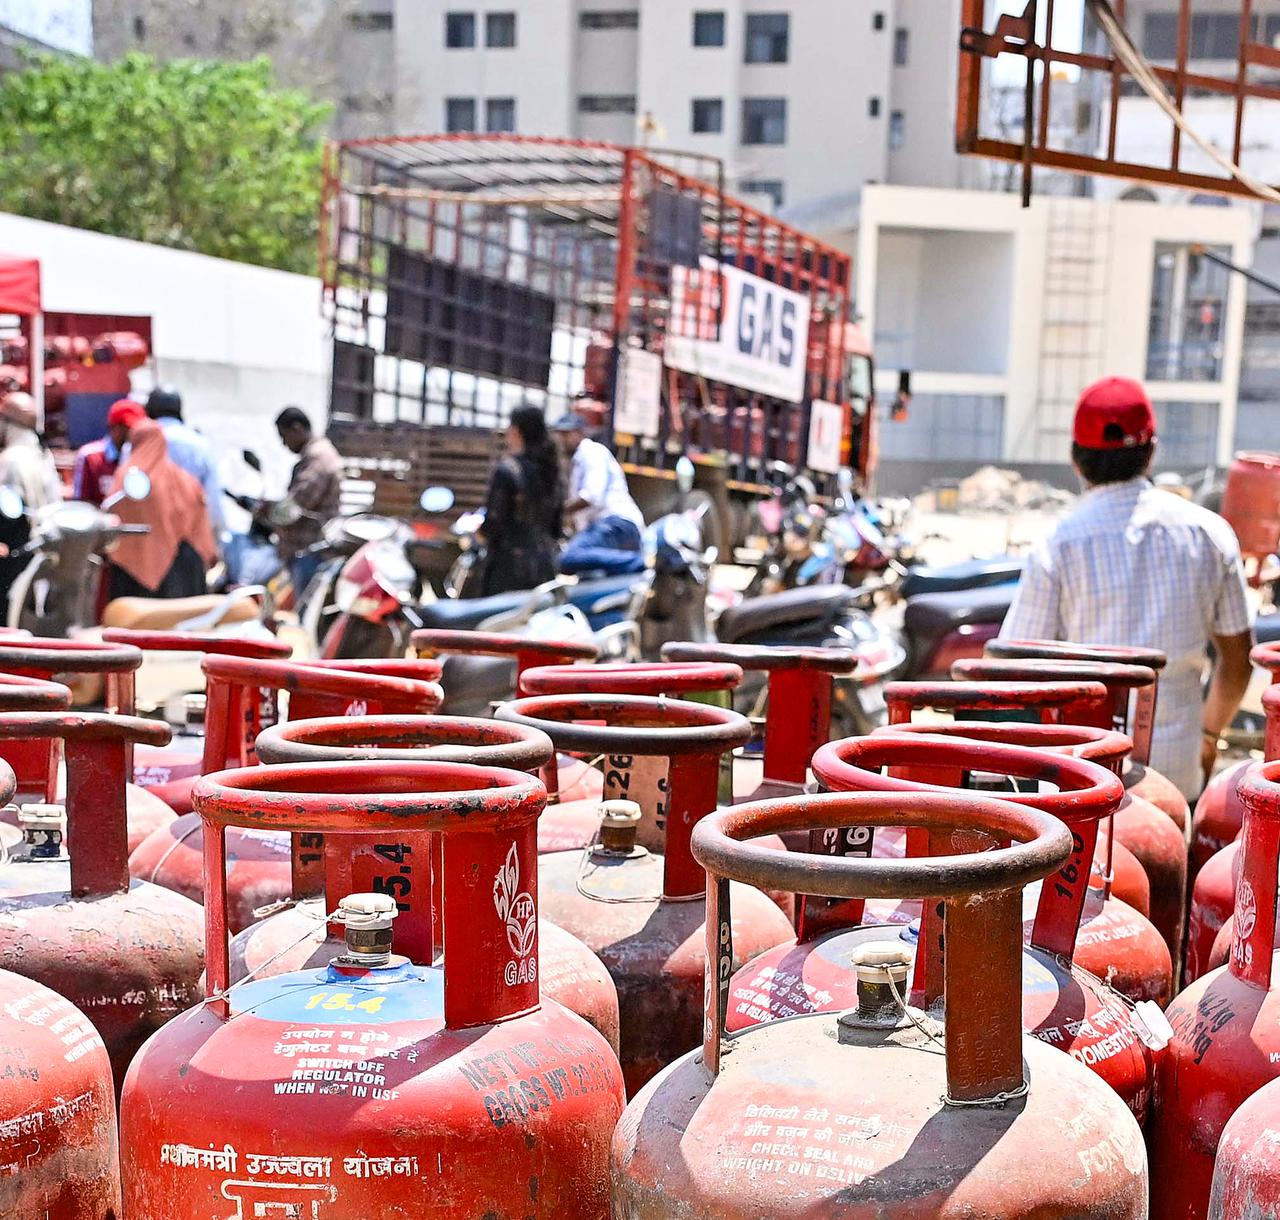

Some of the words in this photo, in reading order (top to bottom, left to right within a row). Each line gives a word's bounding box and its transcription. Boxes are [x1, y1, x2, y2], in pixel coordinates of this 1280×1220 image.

[738, 283, 796, 367] GAS
[1054, 831, 1085, 899] 16.0
[516, 901, 535, 919] HP
[504, 960, 537, 986] GAS
[304, 993, 386, 1014] 15.4
[296, 1058, 354, 1071] SWITCH
[356, 1060, 386, 1073] OFF
[291, 1070, 386, 1087] REGULATOR
[273, 1083, 315, 1096] WHEN
[352, 1086, 367, 1098] IN
[160, 1142, 237, 1172] प्रधानमंत्री
